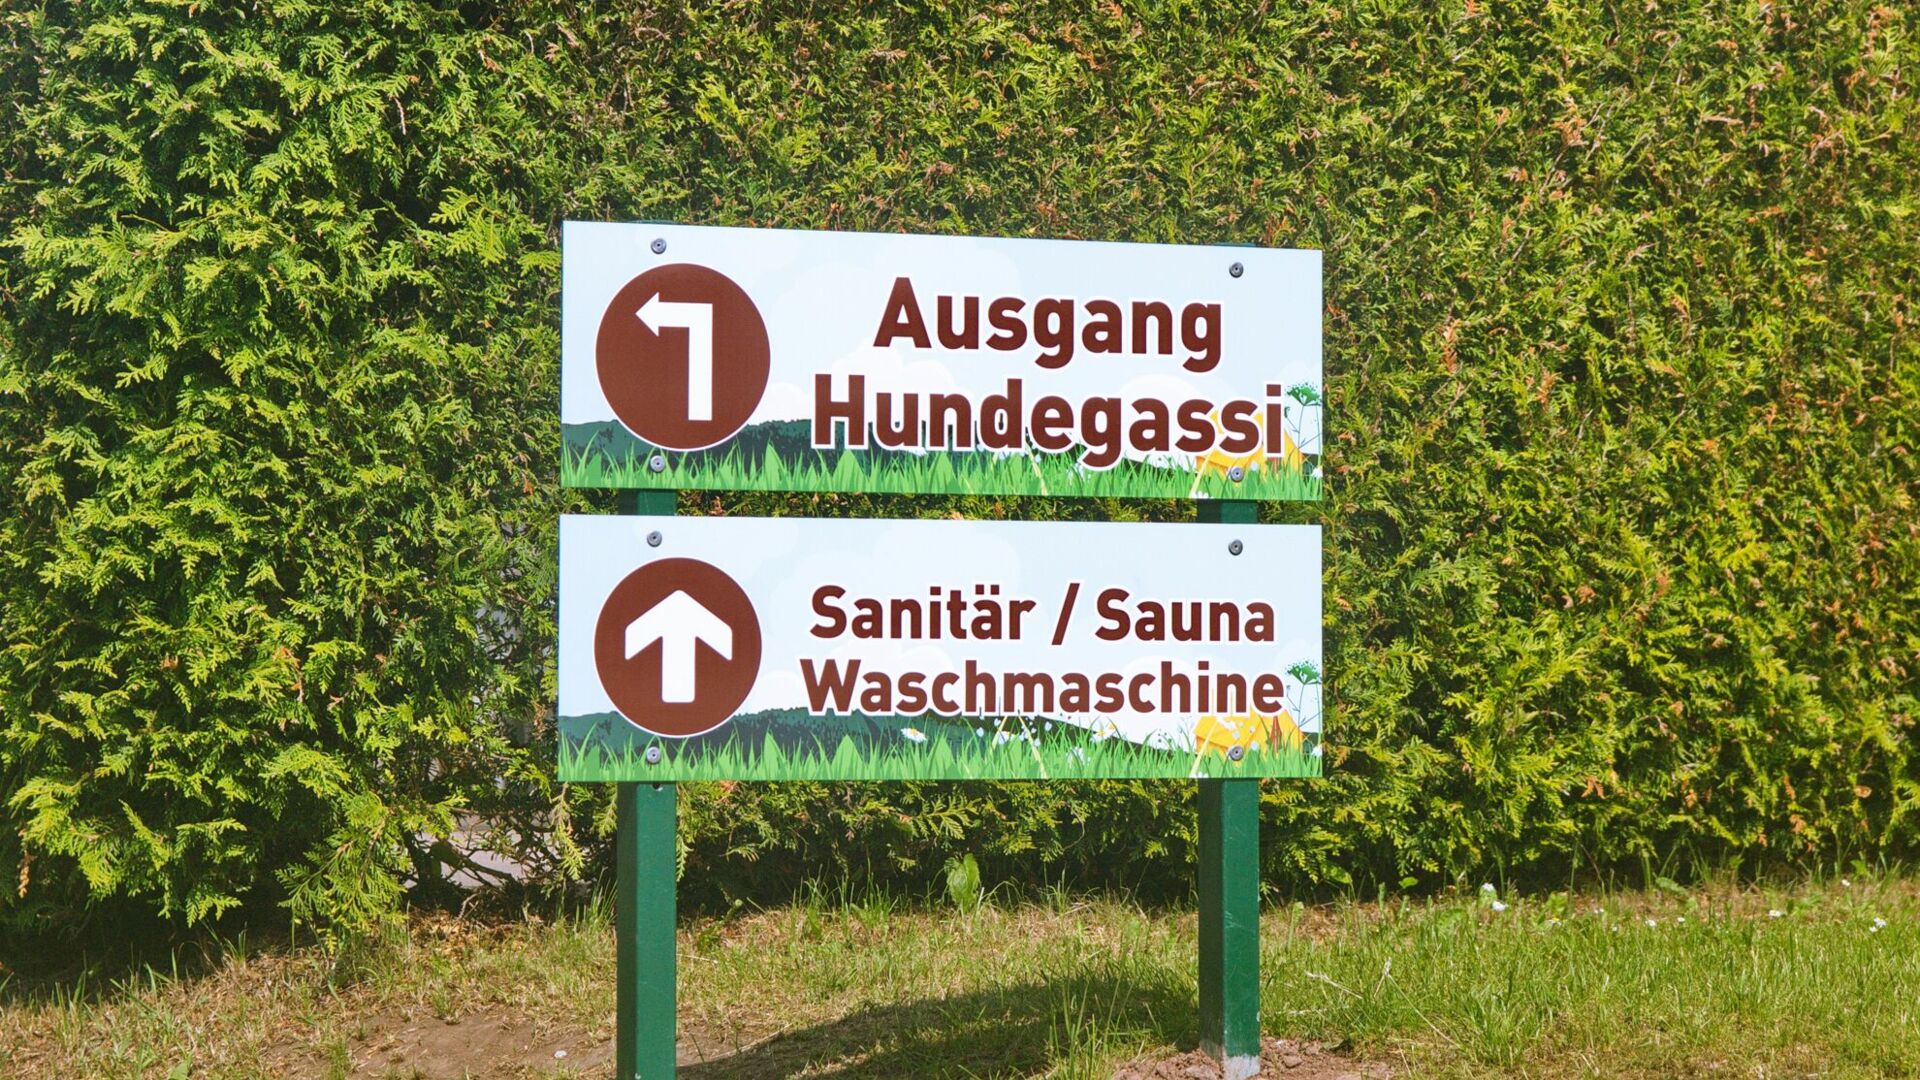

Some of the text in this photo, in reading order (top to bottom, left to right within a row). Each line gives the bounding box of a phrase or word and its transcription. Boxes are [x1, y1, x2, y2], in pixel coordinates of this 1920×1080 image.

[874, 277, 1221, 372] Ausgang
[815, 374, 1283, 468] Hundegassi
[811, 583, 1274, 646] Sanitär / Sauna
[800, 659, 1284, 713] Waschmaschine
